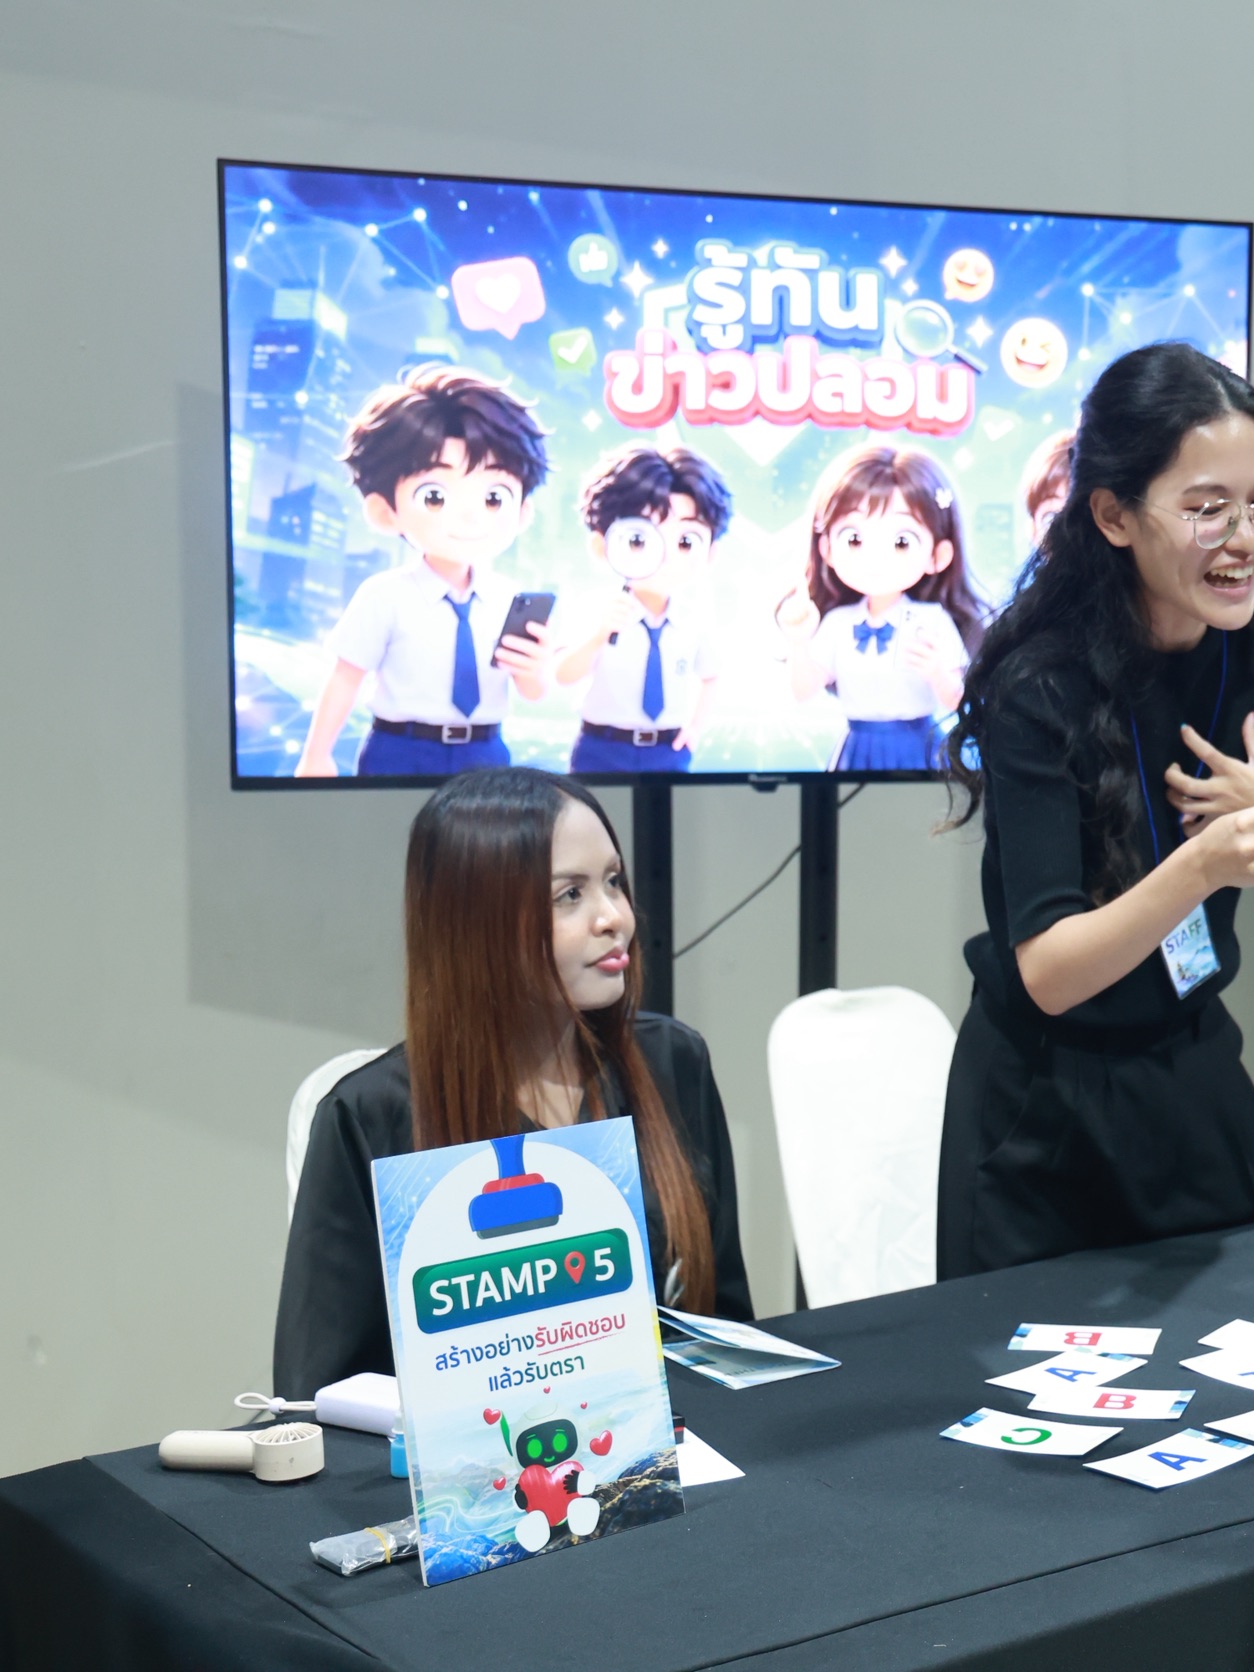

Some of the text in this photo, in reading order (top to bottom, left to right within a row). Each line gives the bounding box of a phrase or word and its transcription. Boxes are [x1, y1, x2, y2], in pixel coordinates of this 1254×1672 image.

[691, 242, 880, 349] รู้ทัน
[608, 330, 970, 426] ข่าวปลอม
[1164, 918, 1203, 955] STAFF
[429, 1247, 615, 1316] STAMP 5
[434, 1313, 627, 1372] สร้างอย่างรับผิดชอบ
[1064, 1331, 1102, 1346] B
[488, 1355, 586, 1392] แล้วรับตรา
[1044, 1366, 1097, 1382] A
[1092, 1393, 1137, 1410] B
[1000, 1427, 1053, 1445] C
[1148, 1450, 1207, 1471] A
